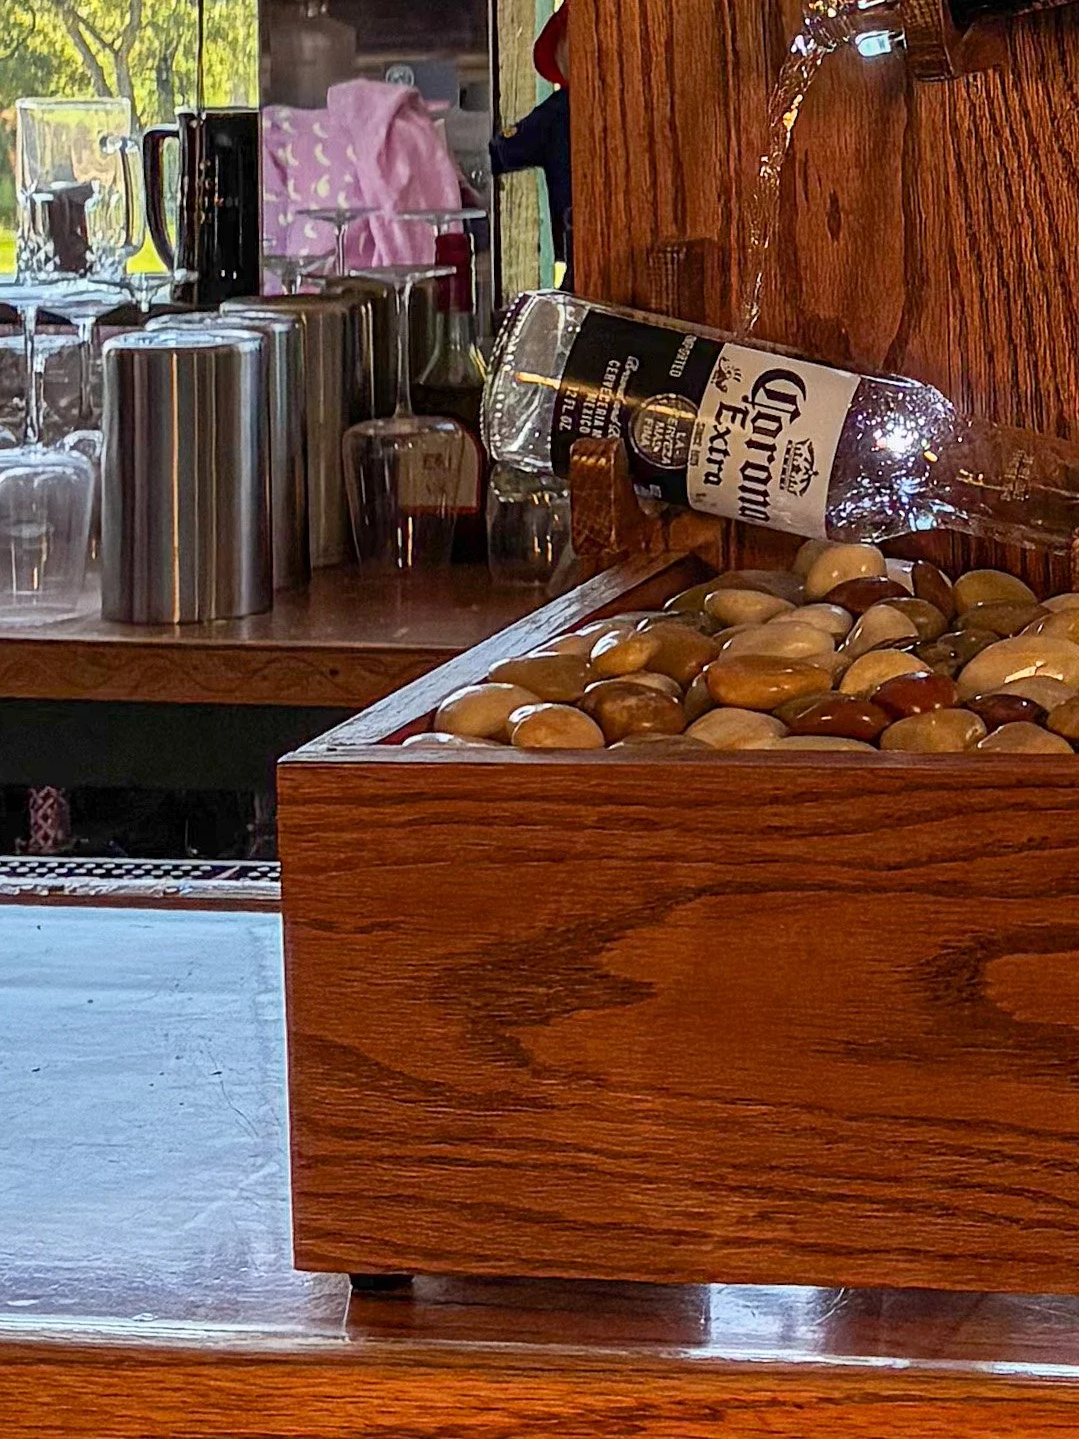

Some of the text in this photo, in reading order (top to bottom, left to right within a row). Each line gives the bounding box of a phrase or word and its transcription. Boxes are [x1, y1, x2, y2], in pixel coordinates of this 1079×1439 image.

[593, 360, 620, 426] CERVECERIA
[675, 432, 685, 447] LA
[702, 401, 747, 486] Extra
[738, 368, 806, 521] Corona
